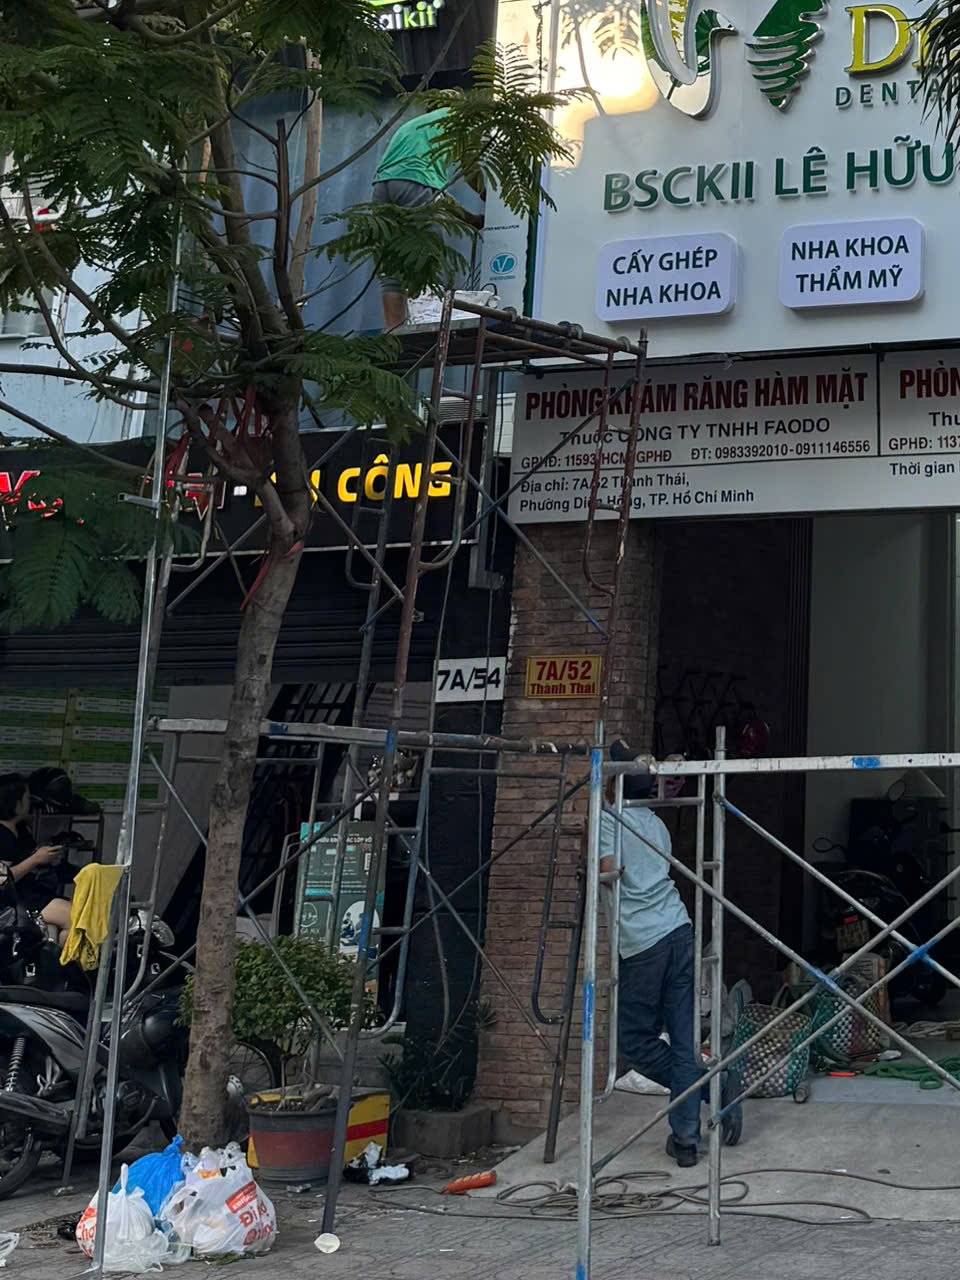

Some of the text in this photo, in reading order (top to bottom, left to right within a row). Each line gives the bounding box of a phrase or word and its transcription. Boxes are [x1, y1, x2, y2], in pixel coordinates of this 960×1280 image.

[603, 160, 755, 213] BSCKII
[775, 145, 828, 197] LÊ
[846, 134, 955, 191] HỮU
[612, 245, 719, 275] CẤY GHÉP
[791, 234, 910, 261] NHA KHOA
[795, 264, 904, 293] THẨM MỸ
[606, 280, 722, 308] NHA KHOA
[525, 382, 604, 421] PHÒNG
[683, 377, 748, 411] RĂNG
[752, 370, 811, 407] HÀM
[815, 367, 867, 410] MẶT
[677, 423, 701, 440] TY
[706, 420, 759, 439] TNHH
[764, 417, 831, 436] FAODO
[690, 446, 713, 462] ĐT:
[715, 439, 871, 460] 0983392010-0911146556
[888, 435, 934, 452] GPHĐ:
[337, 453, 454, 503] CÔNG
[544, 476, 569, 492] chỉ:
[656, 472, 690, 488] Thái,
[889, 459, 922, 476] Thời
[924, 461, 955, 479] gian
[519, 496, 570, 514] Phường
[606, 493, 646, 510] Hg,
[648, 491, 669, 507] TP.
[672, 489, 691, 505] Hồ
[694, 488, 718, 504] Chí
[720, 487, 755, 504] Minh
[437, 666, 502, 692] 7A/54
[535, 659, 593, 682] 7A/52
